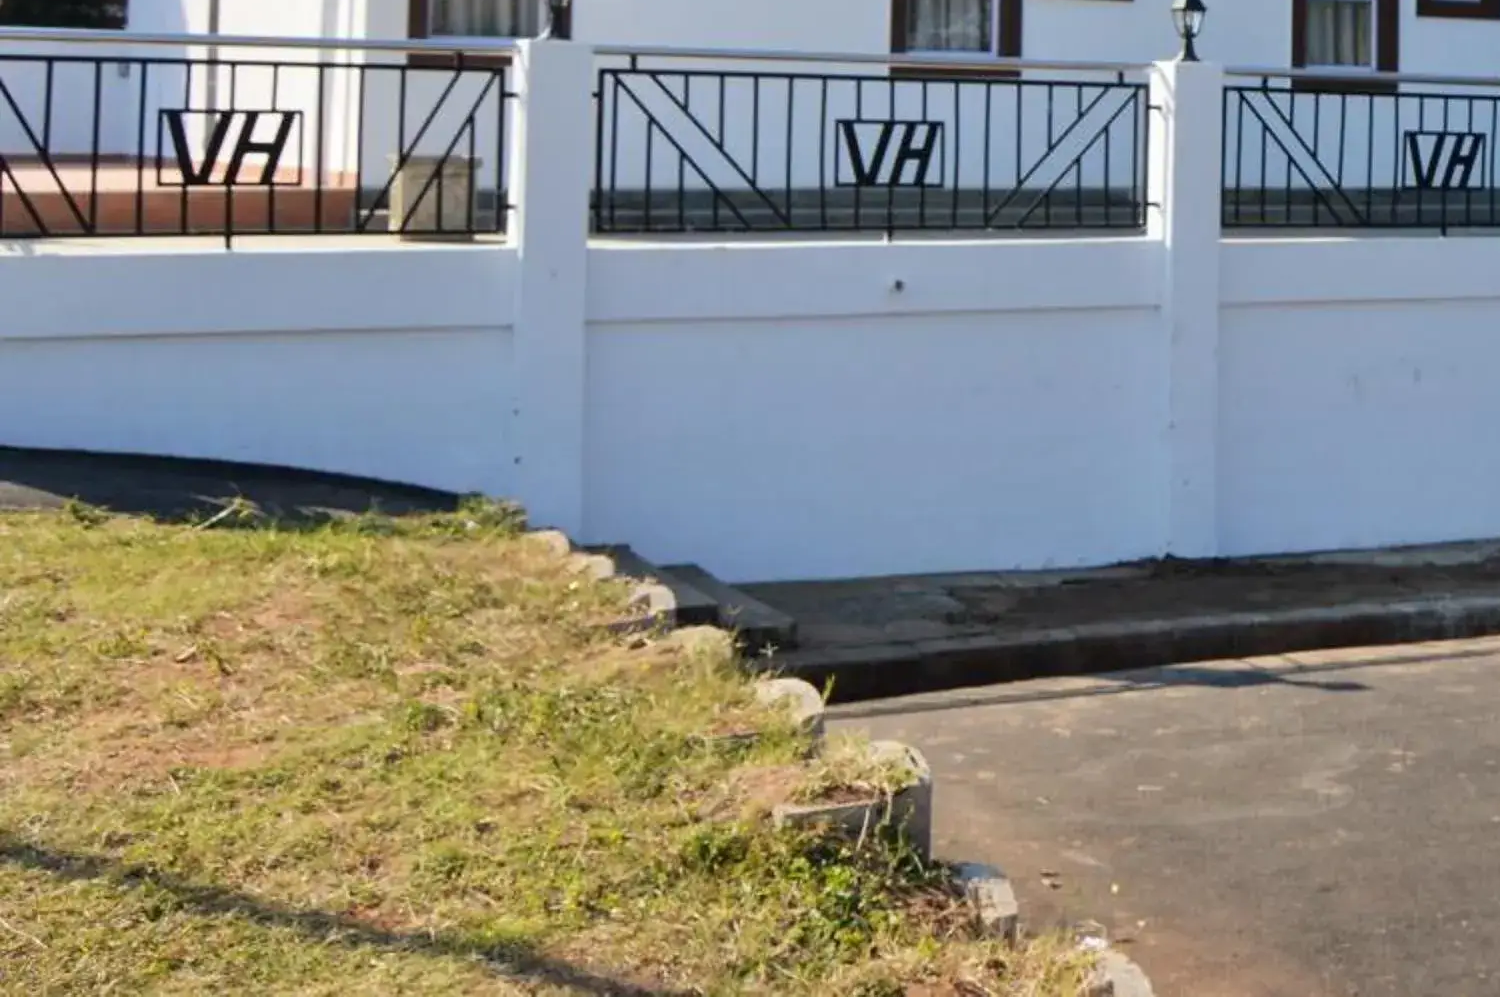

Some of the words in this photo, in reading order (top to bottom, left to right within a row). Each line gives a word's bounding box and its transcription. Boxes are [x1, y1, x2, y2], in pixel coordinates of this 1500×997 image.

[166, 110, 296, 185] VH
[841, 120, 940, 186] VH
[1408, 132, 1482, 190] VH
